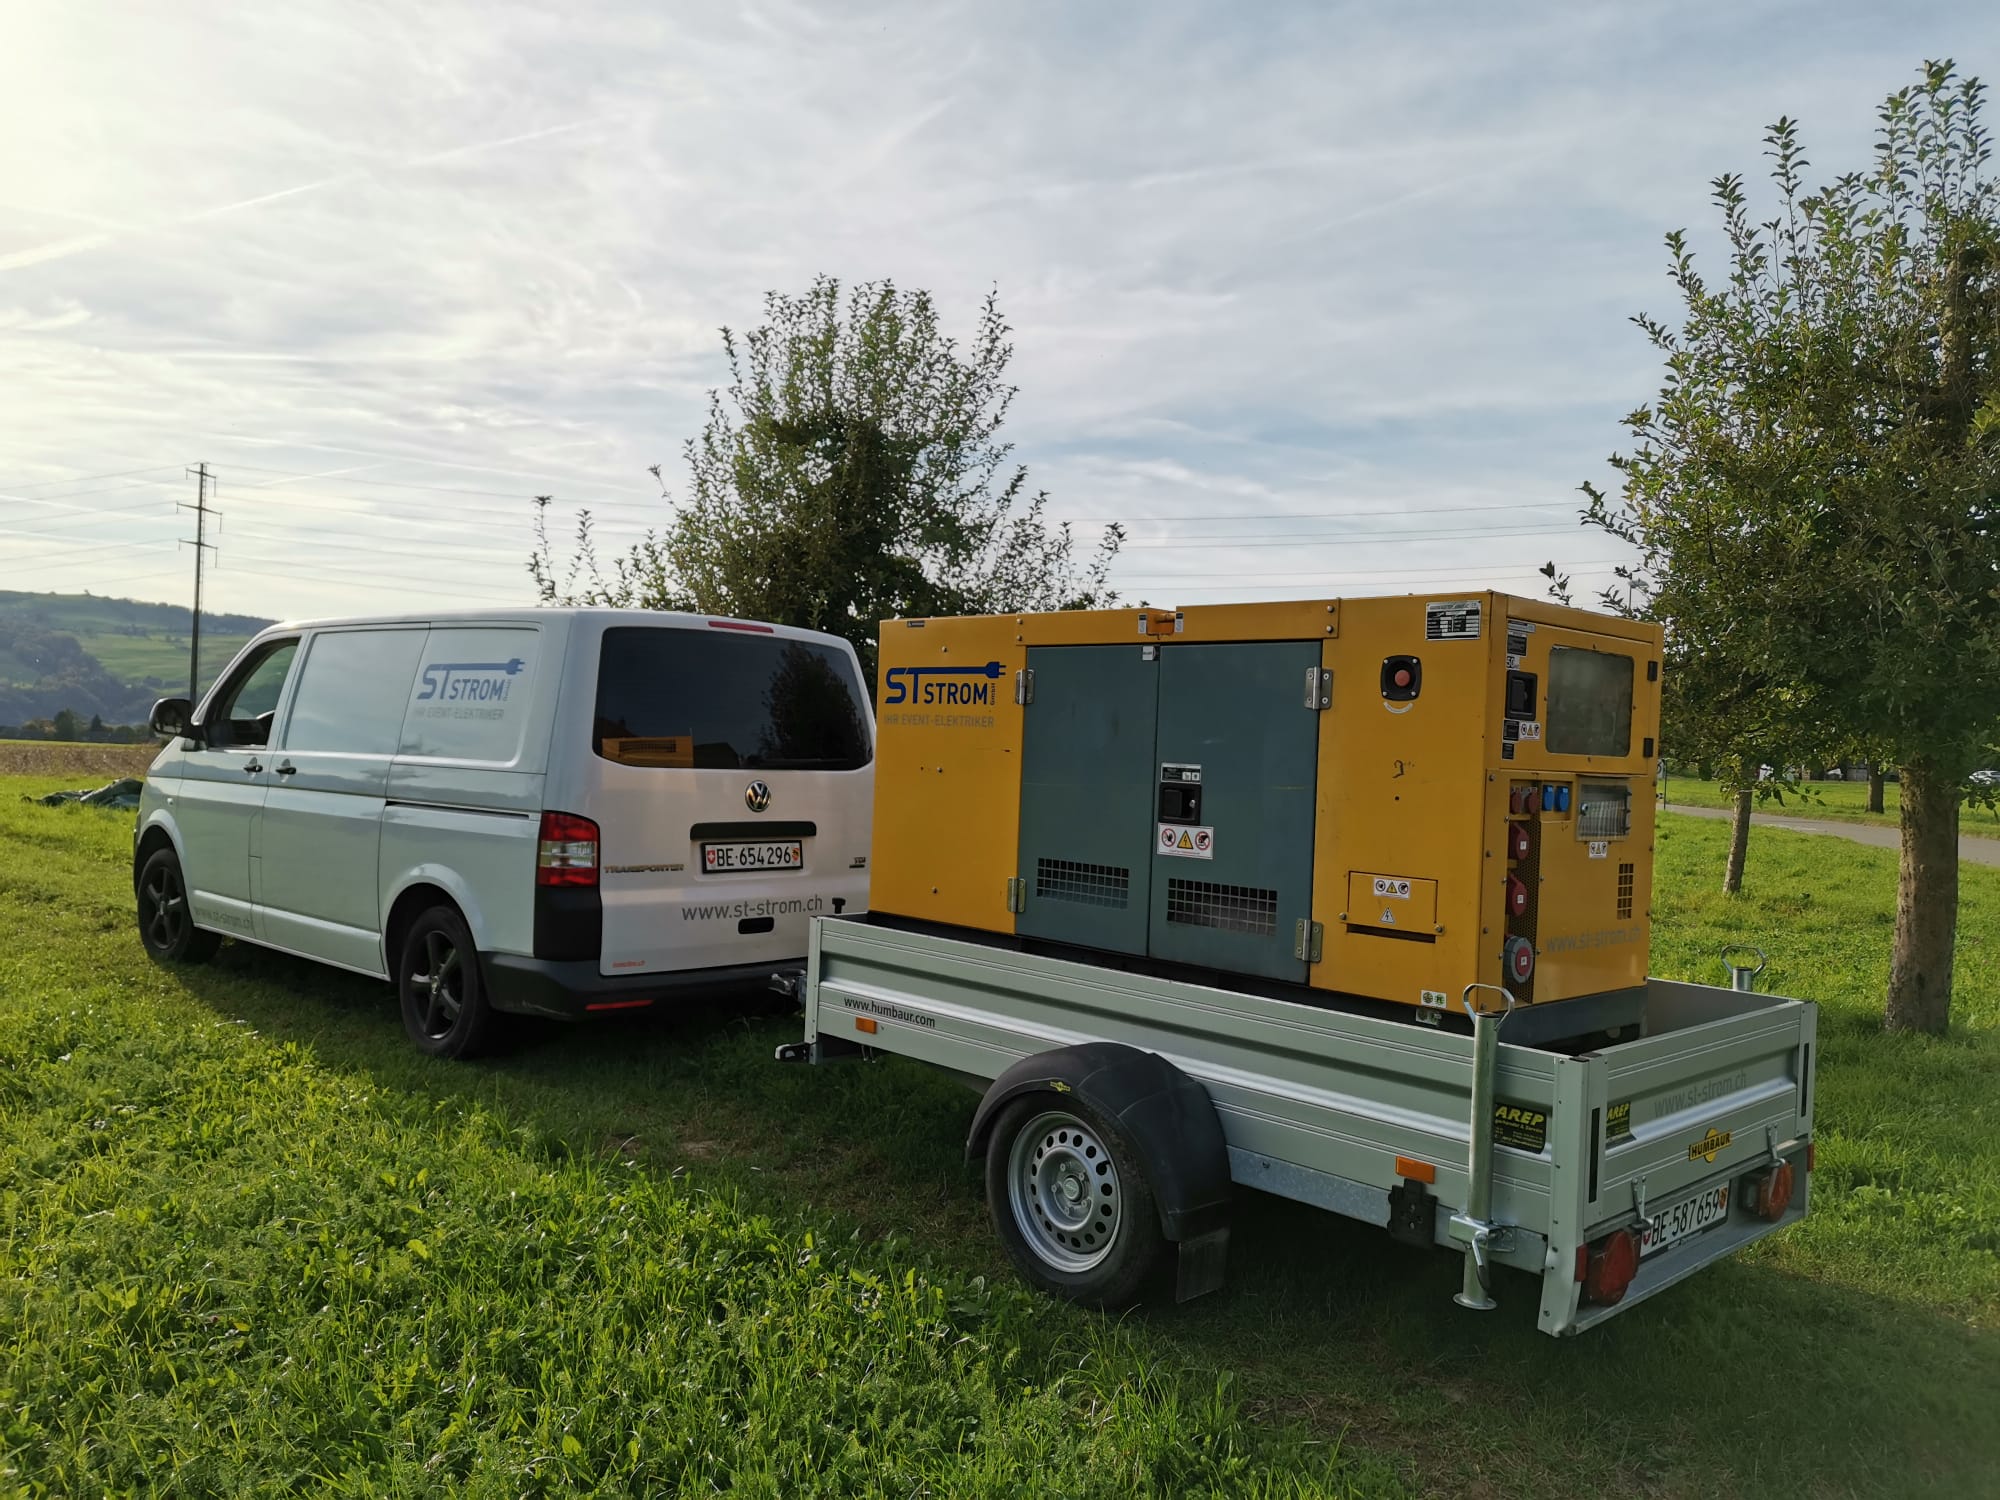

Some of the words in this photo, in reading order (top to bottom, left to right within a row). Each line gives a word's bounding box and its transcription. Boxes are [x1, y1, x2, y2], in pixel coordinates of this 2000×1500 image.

[448, 679, 505, 700] STROM
[924, 683, 988, 705] STROM
[884, 714, 898, 725] IHR
[901, 714, 994, 728] EVENT-ELEKTRIKER
[681, 894, 823, 921] www.st-strom.ch
[1545, 924, 1642, 953] www.st-strom.ch
[843, 997, 936, 1028] www.humbaur.com
[1653, 1069, 1747, 1118] www.st-strom.ch
[1495, 1106, 1545, 1126] AREP
[1607, 1103, 1630, 1121] AREP
[1691, 1133, 1730, 1158] HUMBAUR
